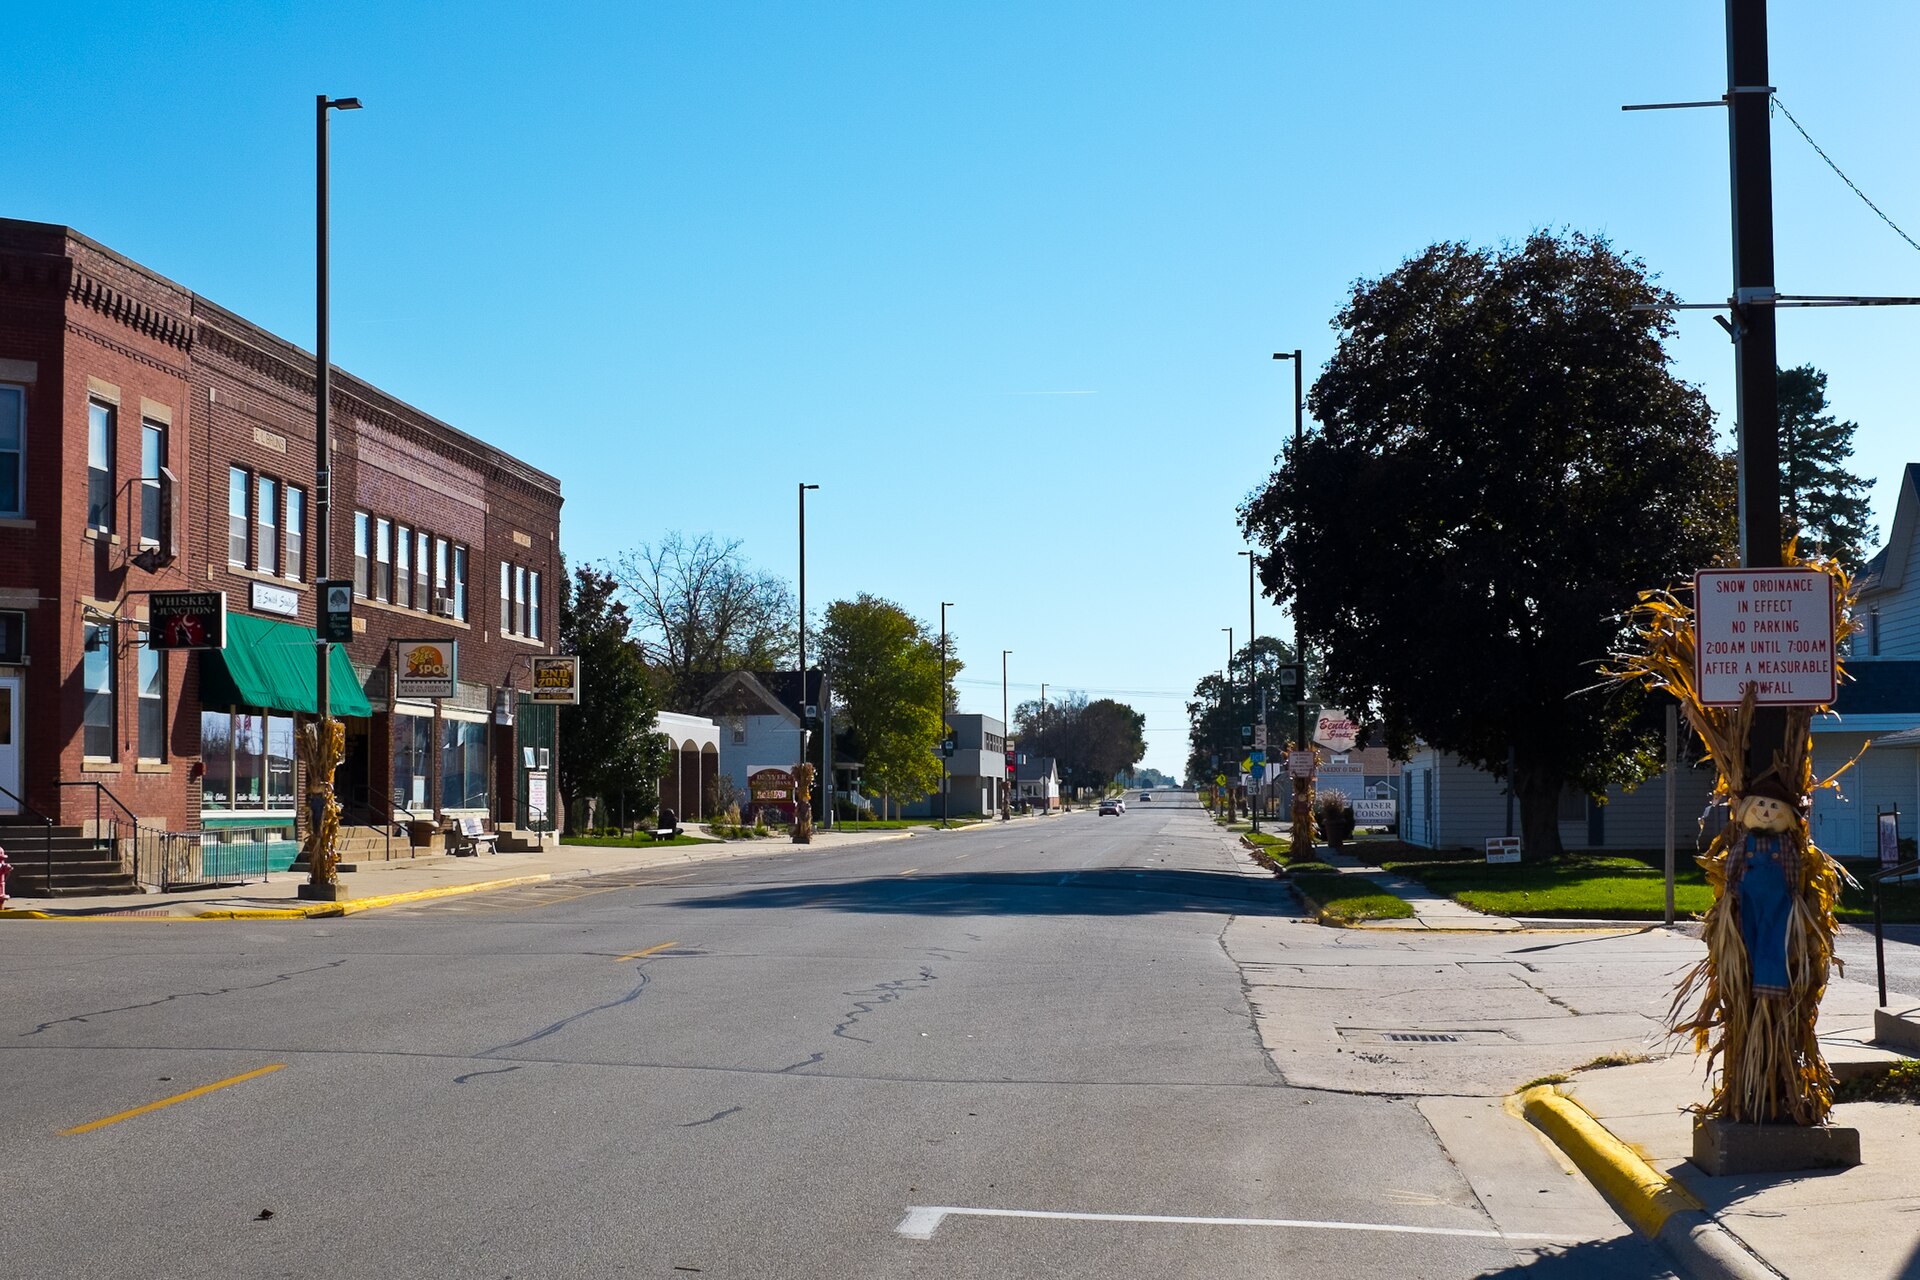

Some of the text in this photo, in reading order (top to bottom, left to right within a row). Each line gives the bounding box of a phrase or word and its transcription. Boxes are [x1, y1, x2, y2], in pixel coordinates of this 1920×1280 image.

[1716, 579, 1813, 593] SNOW ORDINANCE
[155, 596, 215, 606] WHISKEY
[1738, 600, 1793, 613] IN EFFECT
[159, 607, 211, 615] JUNCTION
[1732, 620, 1799, 633] NO PARKING
[1751, 640, 1781, 653] UNTIL
[419, 664, 449, 675] SPOT
[1705, 660, 1829, 674] AFTER A MEASURABLE
[540, 669, 569, 677] END
[538, 677, 570, 688] ZONE
[1355, 810, 1393, 818] CORSON
